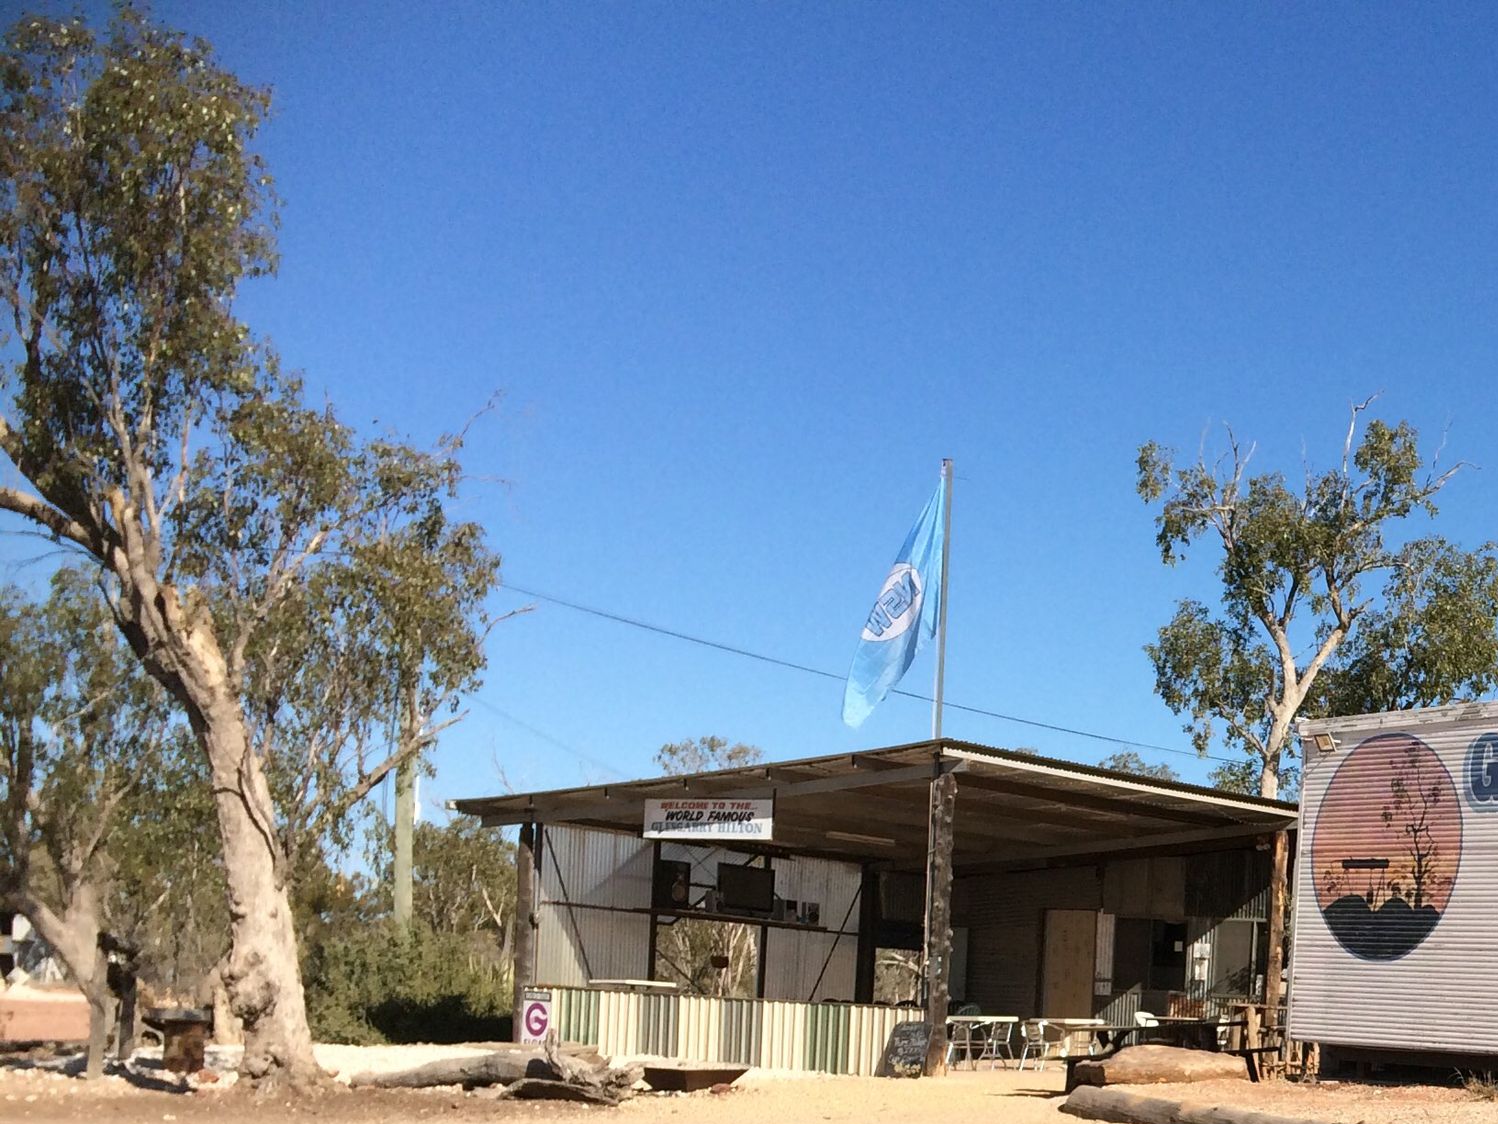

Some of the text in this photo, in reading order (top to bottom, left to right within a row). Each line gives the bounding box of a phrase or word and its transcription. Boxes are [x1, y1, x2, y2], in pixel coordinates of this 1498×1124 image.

[660, 801, 709, 810] WELCOME
[711, 801, 727, 810] TO
[665, 809, 755, 825] WORLD FAMOUS
[650, 821, 763, 834] GLENGARRY HILTON
[525, 1002, 548, 1037] G
